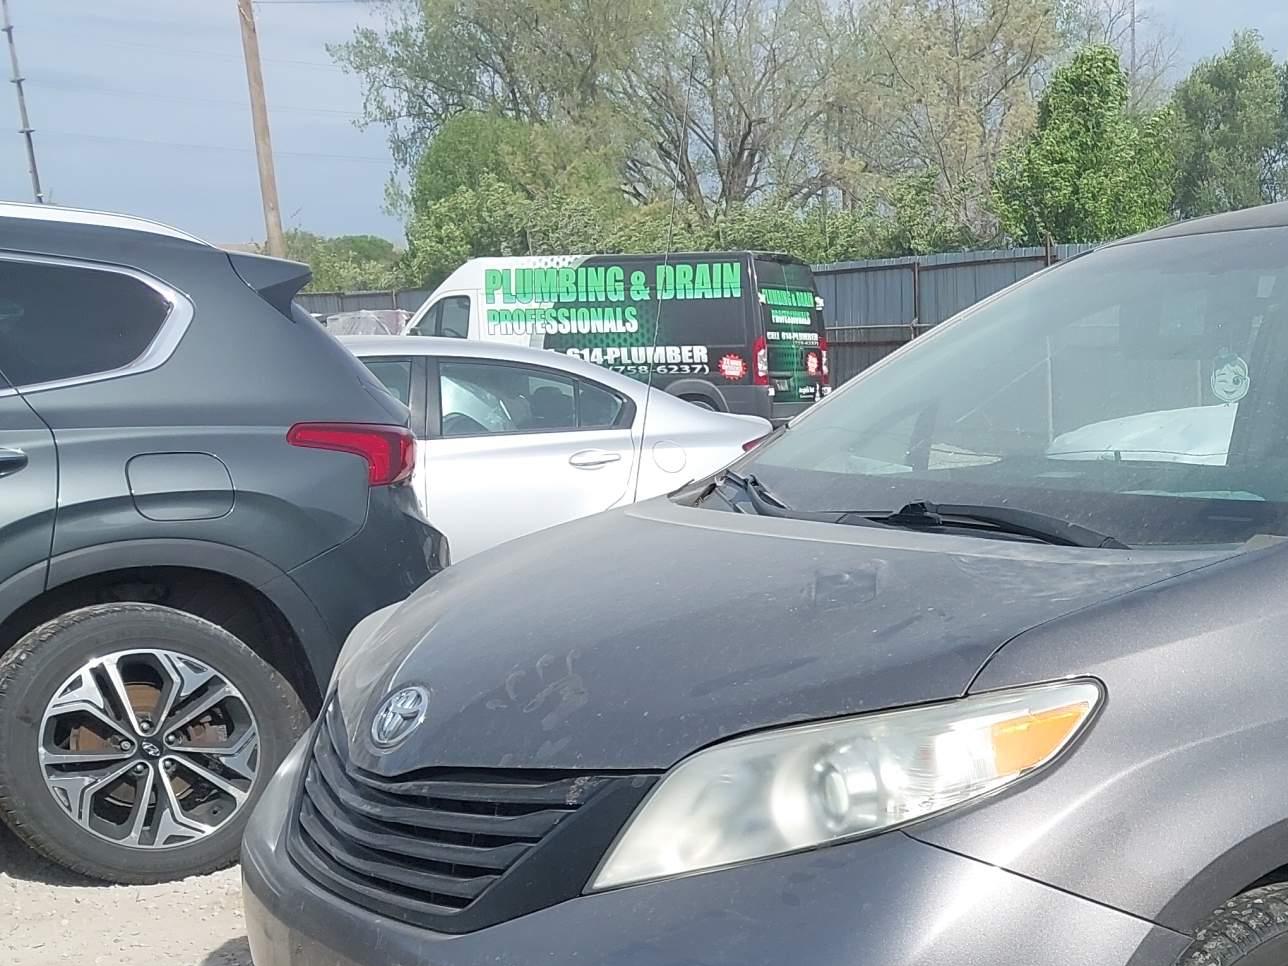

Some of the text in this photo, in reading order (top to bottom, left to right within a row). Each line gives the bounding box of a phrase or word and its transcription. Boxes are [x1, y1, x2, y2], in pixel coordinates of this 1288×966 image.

[484, 266, 625, 304] PLUMBING
[630, 270, 650, 300] &
[656, 262, 741, 300] DRAIN
[487, 306, 639, 335] PROFESSIONALS
